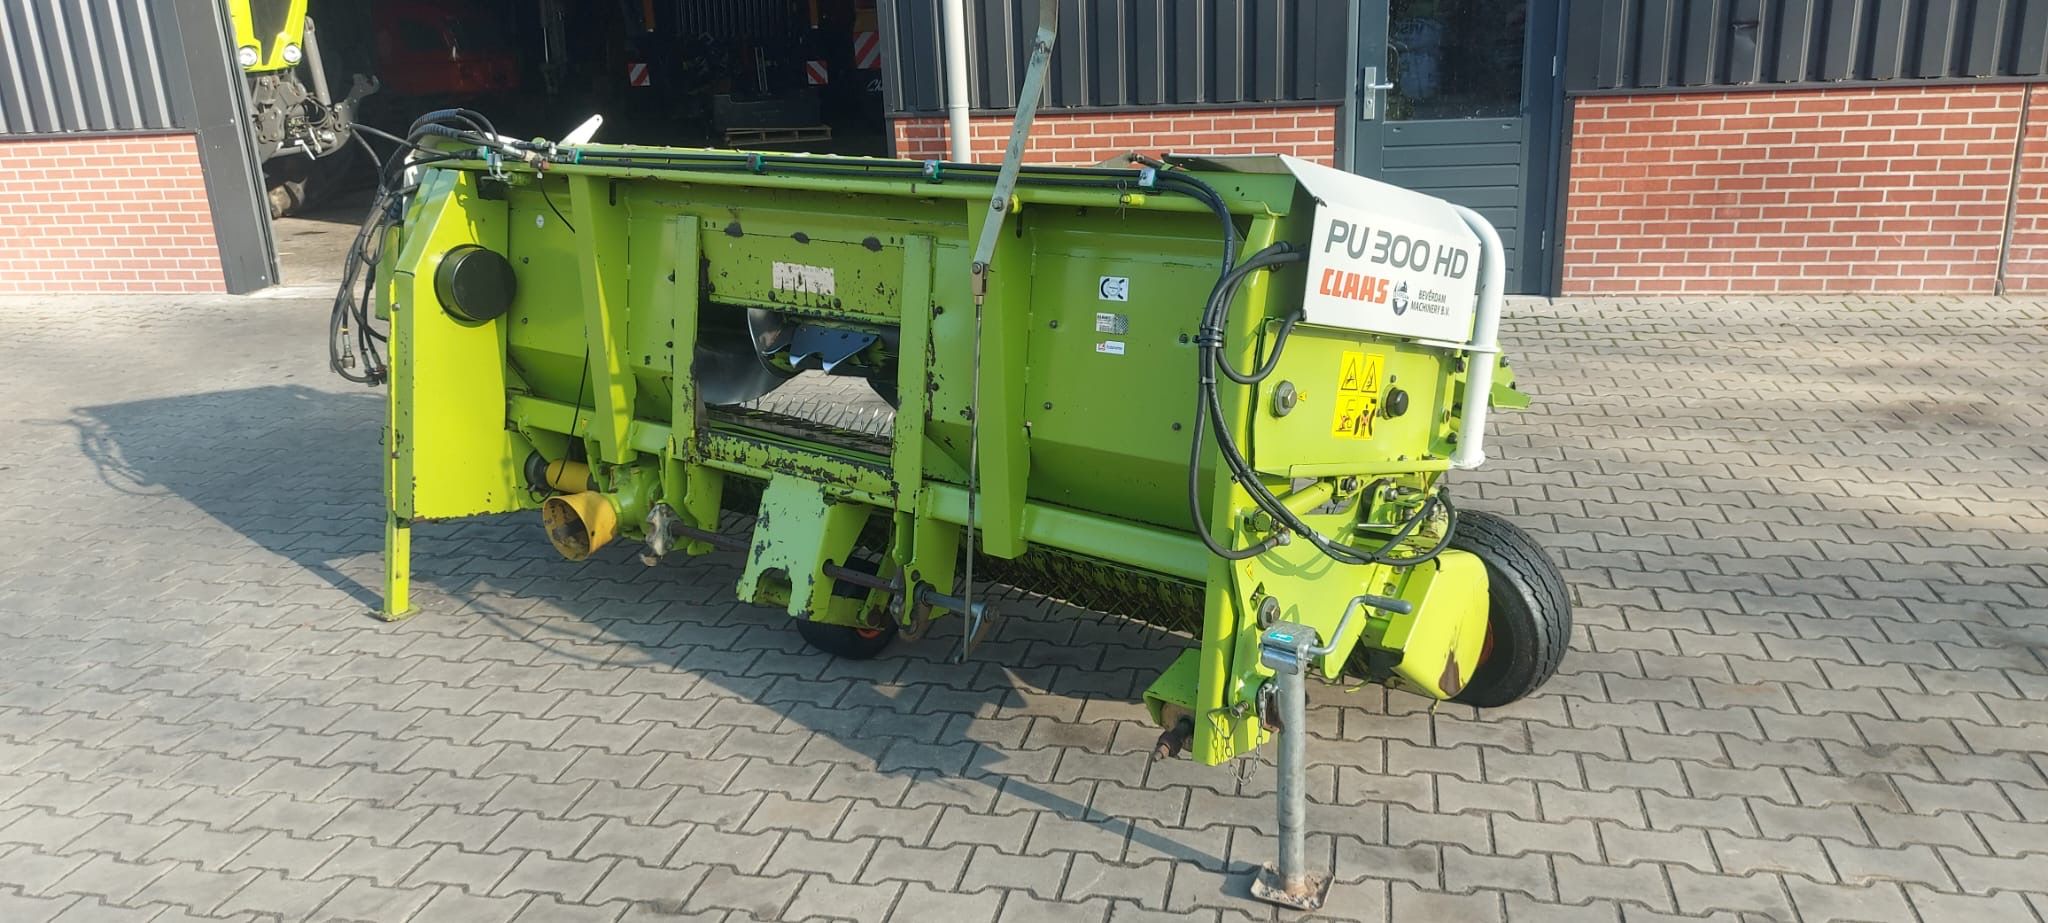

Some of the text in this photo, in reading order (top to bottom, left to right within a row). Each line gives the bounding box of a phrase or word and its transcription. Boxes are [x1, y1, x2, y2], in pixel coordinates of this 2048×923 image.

[1324, 219, 1469, 279] PU 300 HD
[1320, 268, 1389, 304] CLAAS
[1411, 300, 1440, 313] MACHINERY
